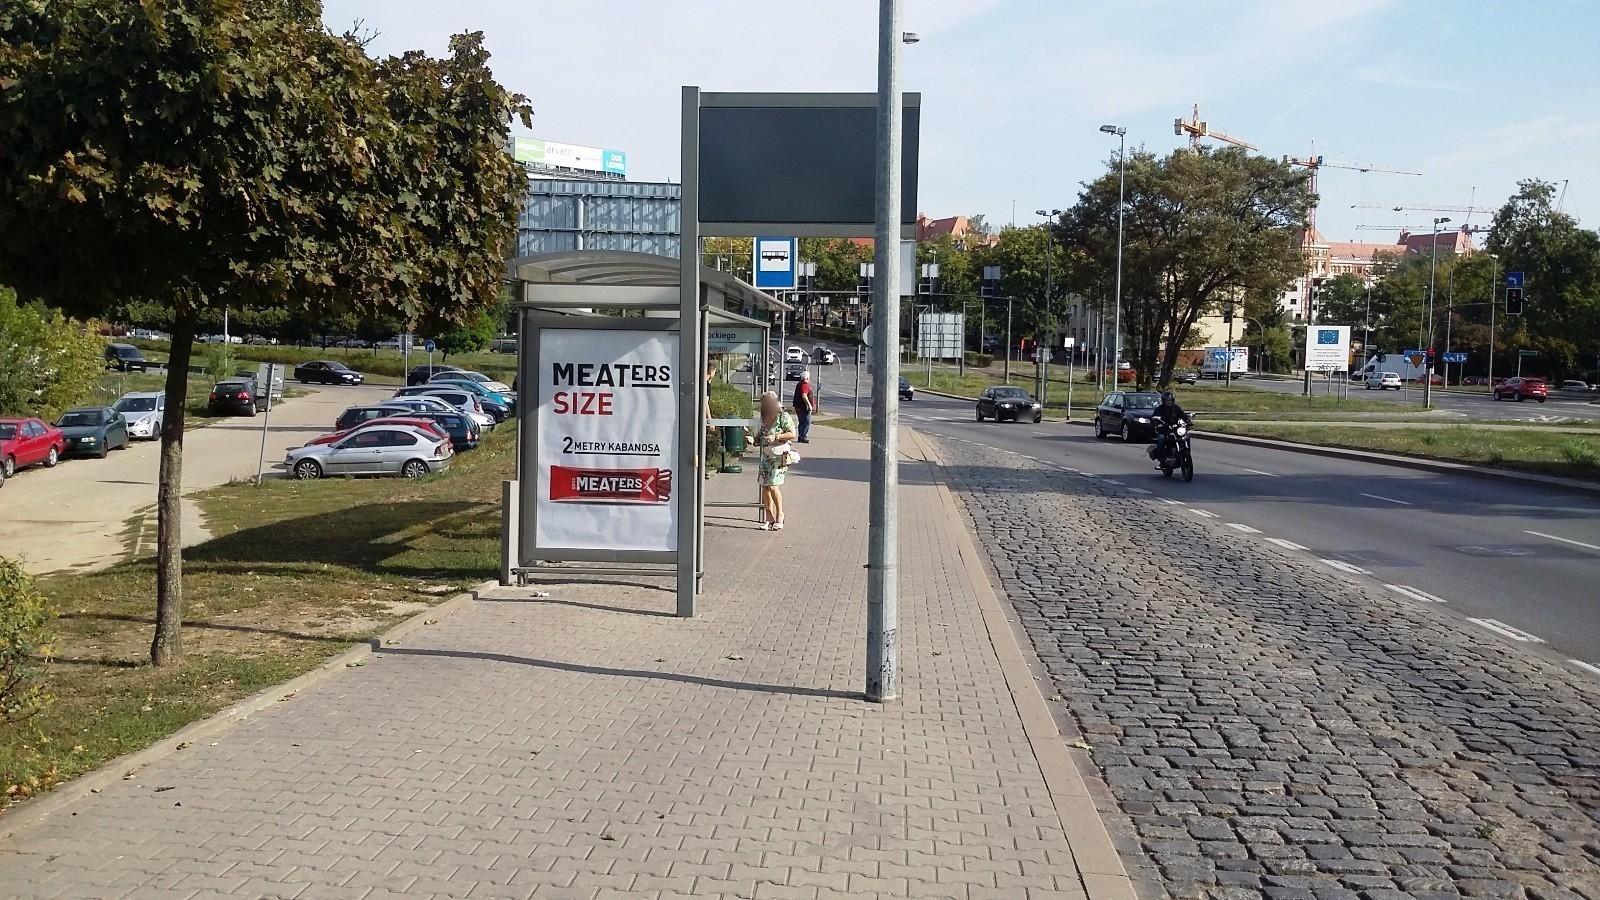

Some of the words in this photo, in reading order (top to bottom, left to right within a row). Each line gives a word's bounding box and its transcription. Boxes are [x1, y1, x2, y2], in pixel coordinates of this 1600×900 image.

[552, 362, 670, 388] MEATERS
[553, 391, 614, 416] SIZE
[562, 436, 573, 454] 2
[574, 441, 606, 451] METRY
[608, 442, 660, 453] KABANOSA
[576, 476, 643, 492] MEATERS
